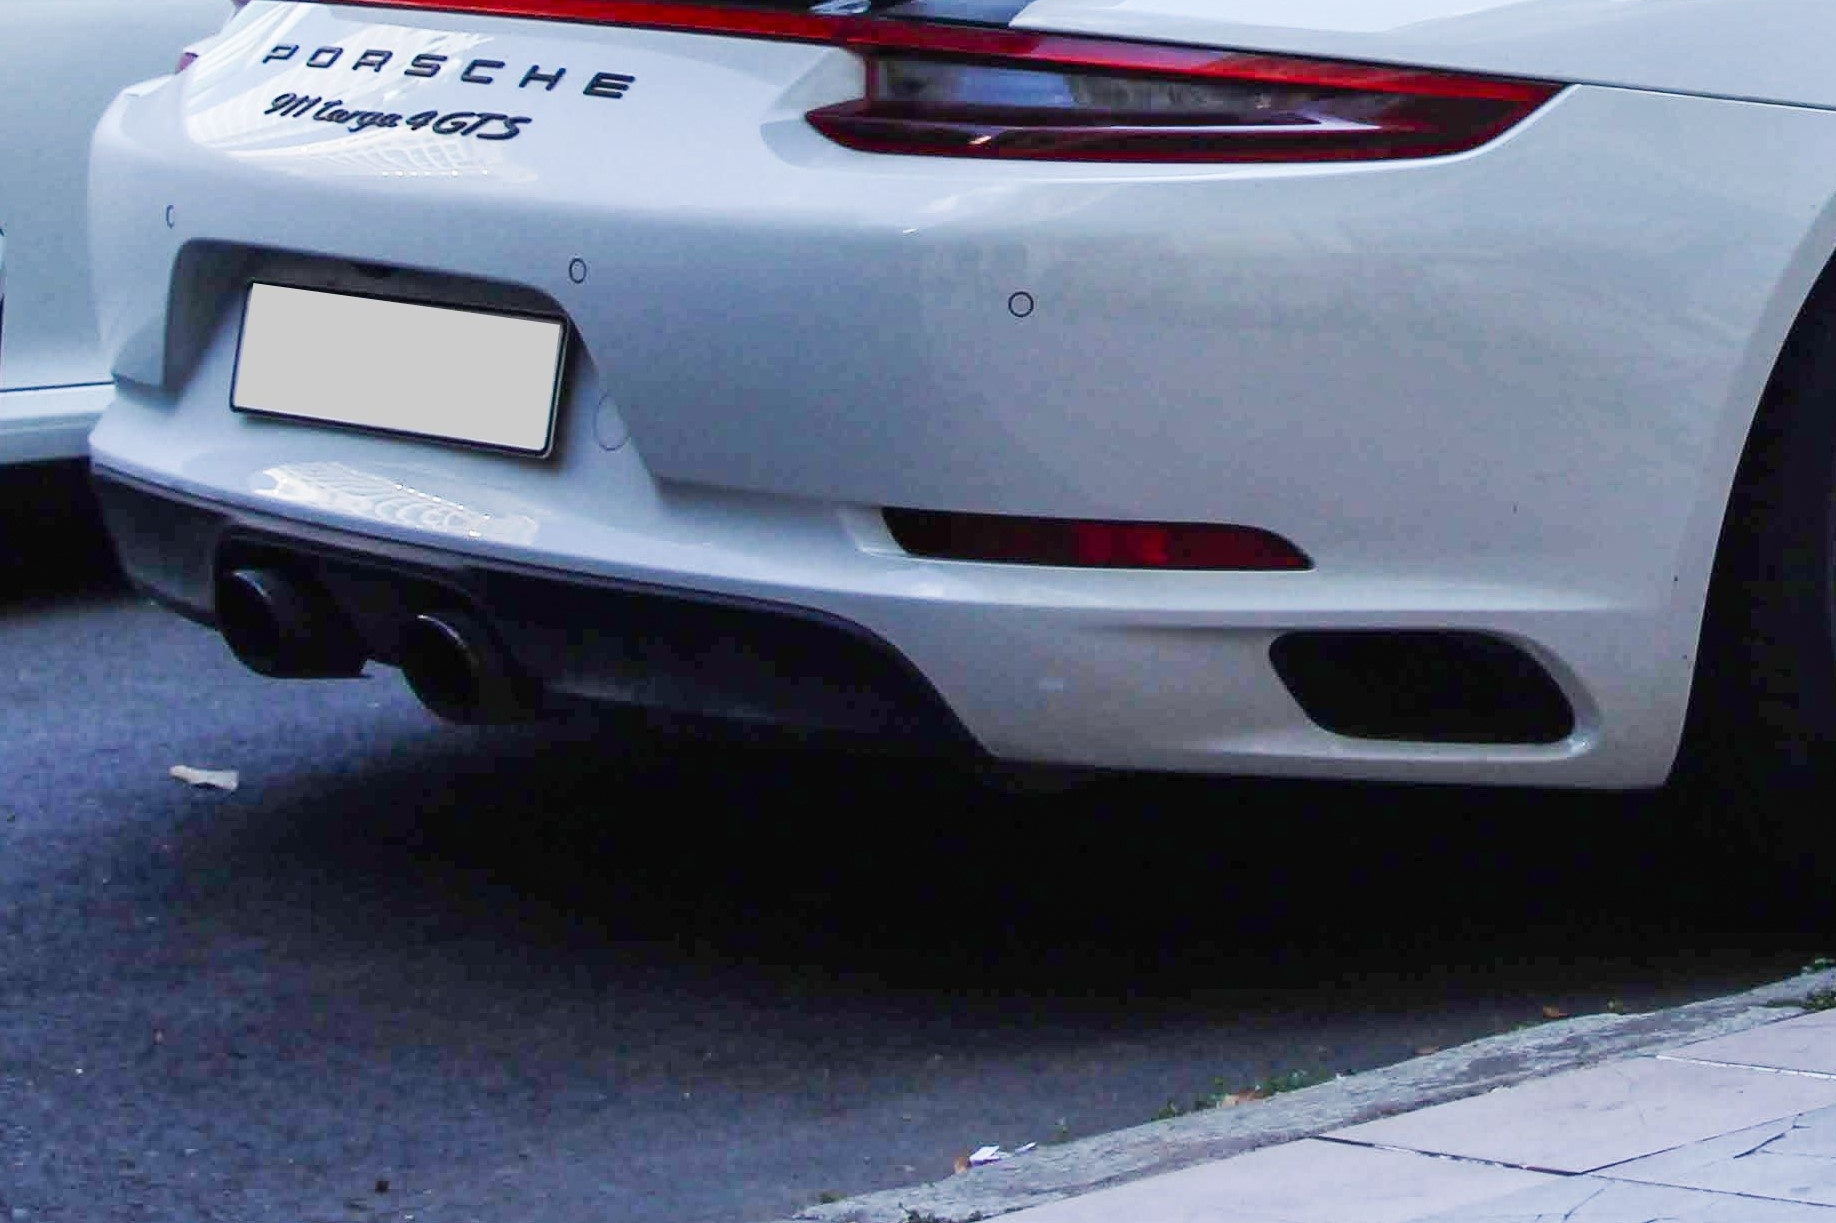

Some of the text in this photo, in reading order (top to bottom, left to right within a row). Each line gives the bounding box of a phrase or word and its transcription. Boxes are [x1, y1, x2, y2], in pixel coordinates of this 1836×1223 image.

[262, 44, 636, 99] PORSCHE
[264, 92, 322, 117] 911
[431, 110, 533, 140] GTS
